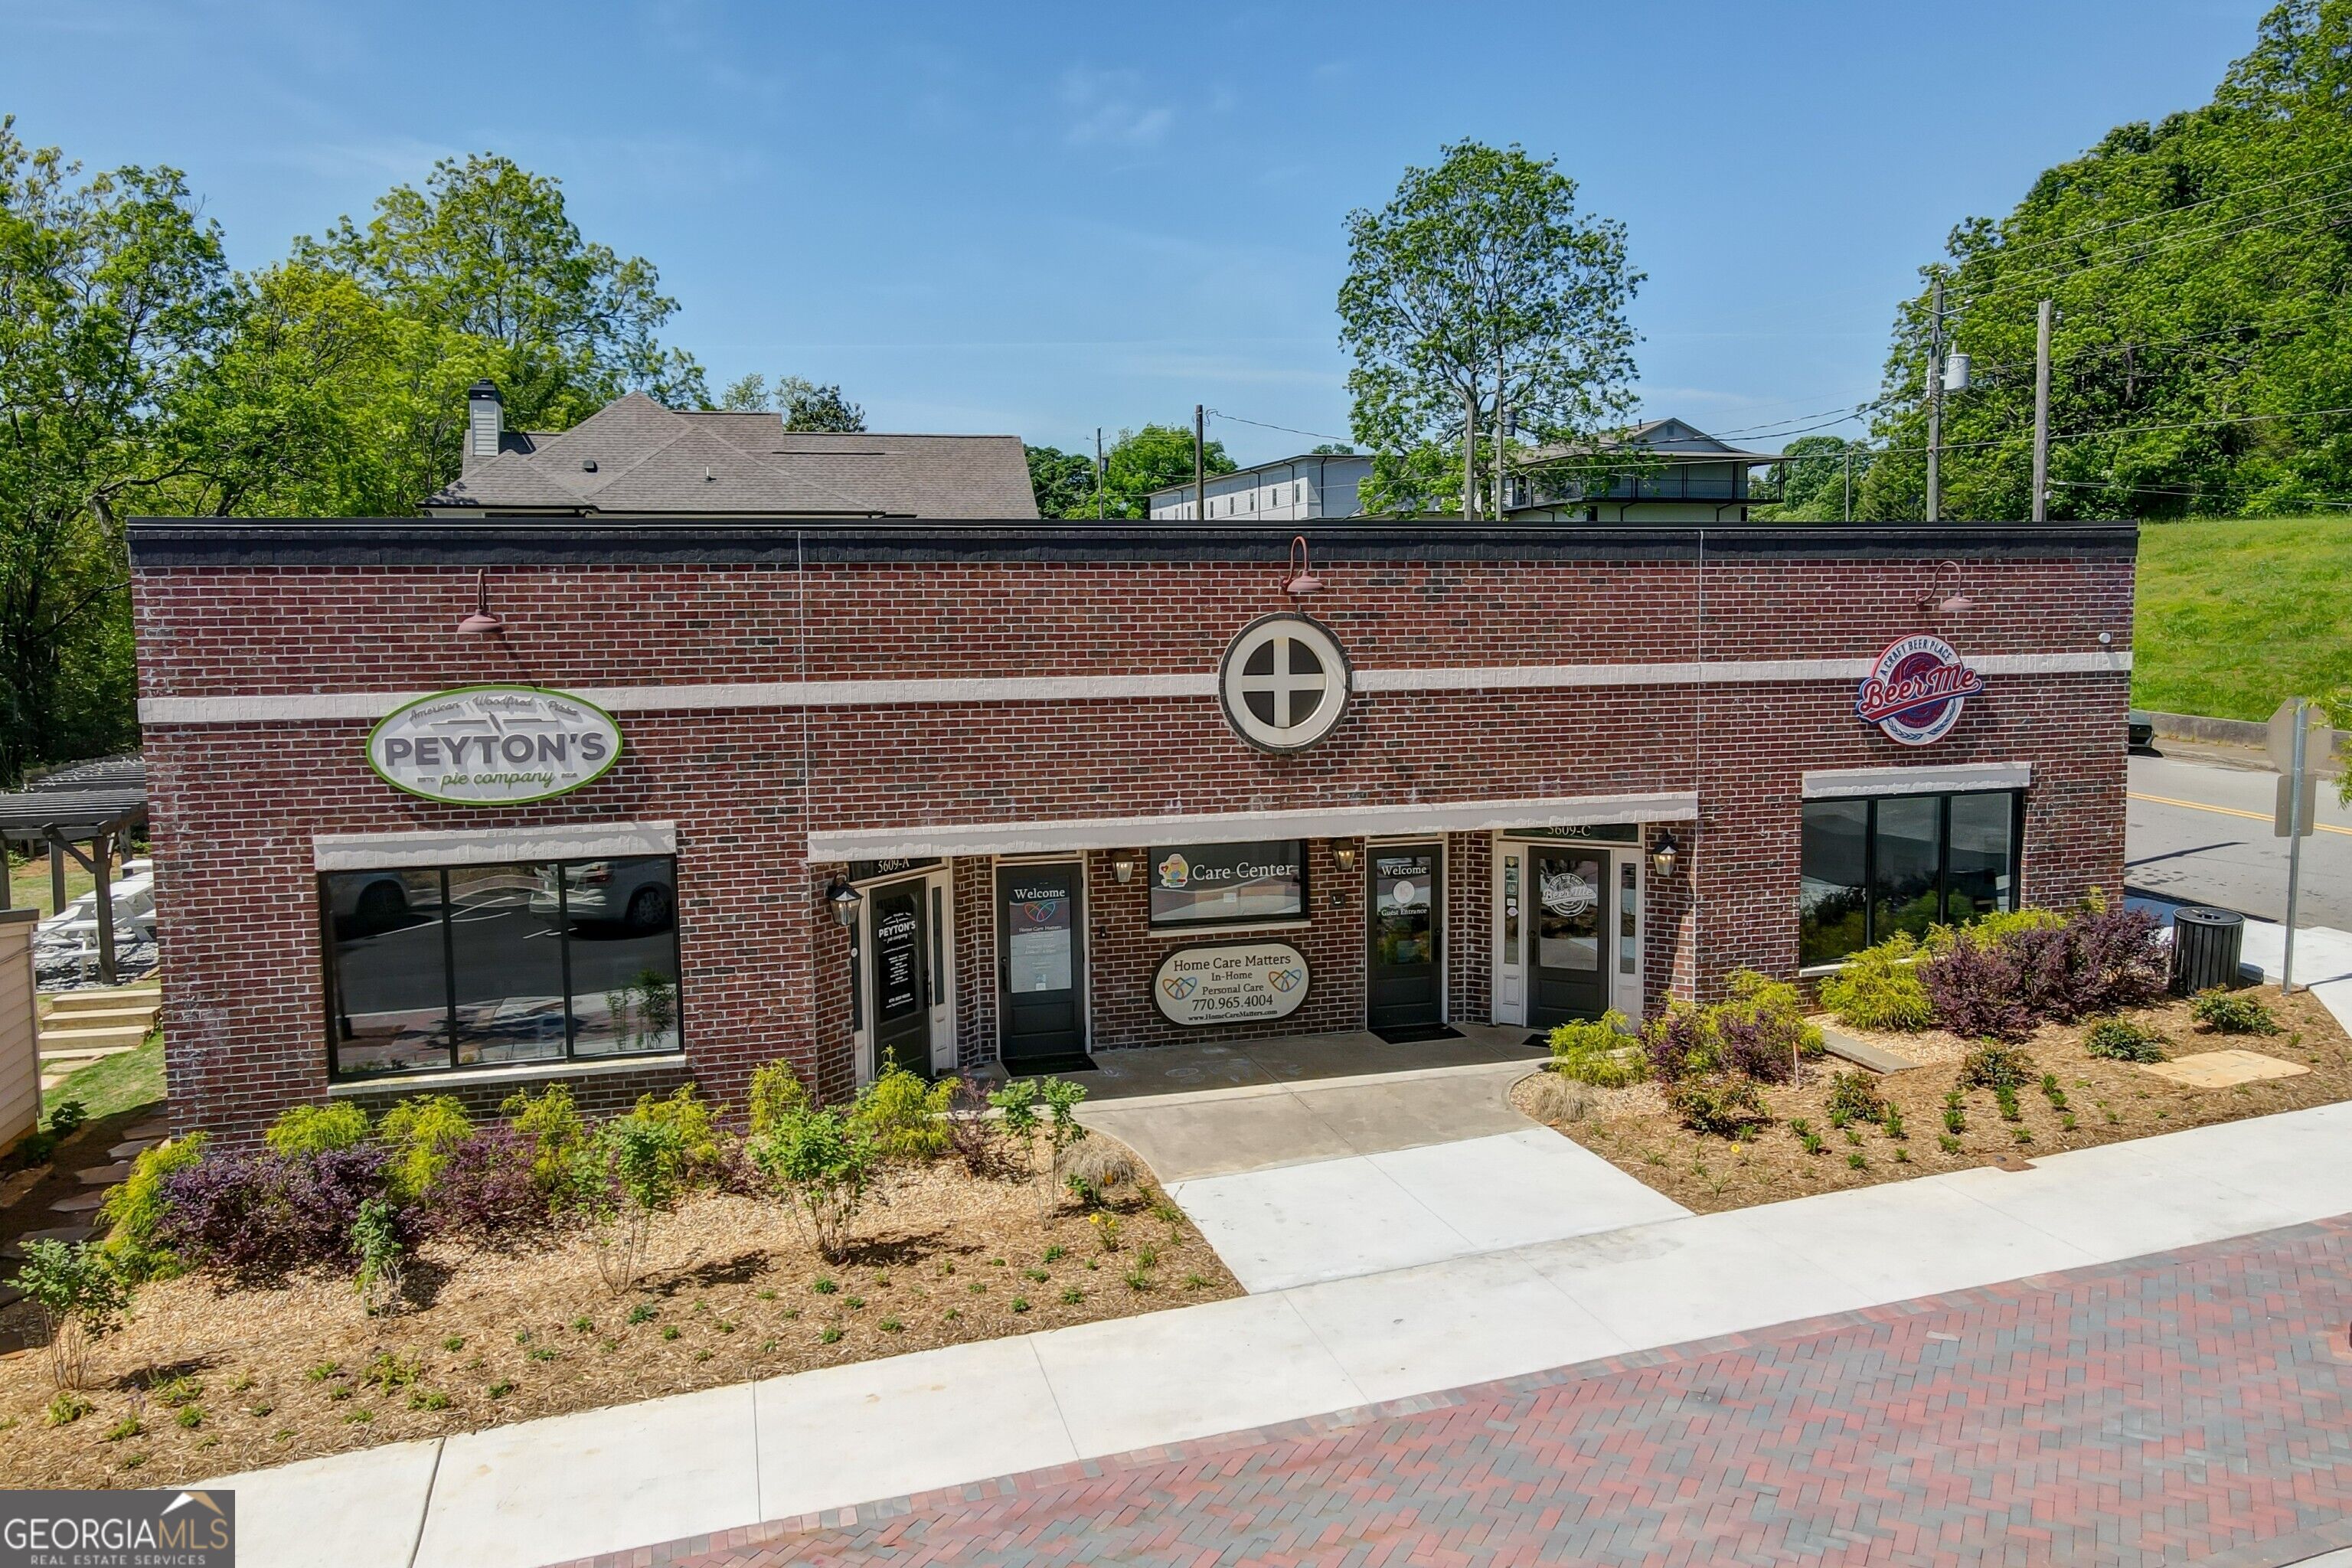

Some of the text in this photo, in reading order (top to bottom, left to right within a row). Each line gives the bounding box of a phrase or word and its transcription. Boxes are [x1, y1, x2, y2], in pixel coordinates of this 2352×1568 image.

[1884, 645, 1907, 668] CRAFT
[1909, 639, 1928, 651] BEER
[1929, 641, 1952, 662] PLACE
[1860, 664, 1981, 712] Beer Me
[409, 701, 460, 720] American
[384, 732, 606, 766] PEYTON'S
[440, 773, 469, 792] pie
[473, 772, 554, 789] company
[1547, 826, 1592, 837] 5609-C
[877, 858, 910, 873] 5609-A
[1192, 862, 1293, 880] Care Center
[1381, 865, 1427, 876] Welcome
[1014, 888, 1066, 900] Welcome
[1544, 888, 1570, 900] Beer
[878, 920, 916, 938] PEYTON'S
[1173, 955, 1291, 972] Home Care Matters
[1210, 972, 1253, 982] In-Home
[1202, 983, 1264, 995] Personal Care
[1192, 995, 1273, 1011] 770.965.4004
[1187, 1009, 1278, 1022] www.HomeCareMatters.com
